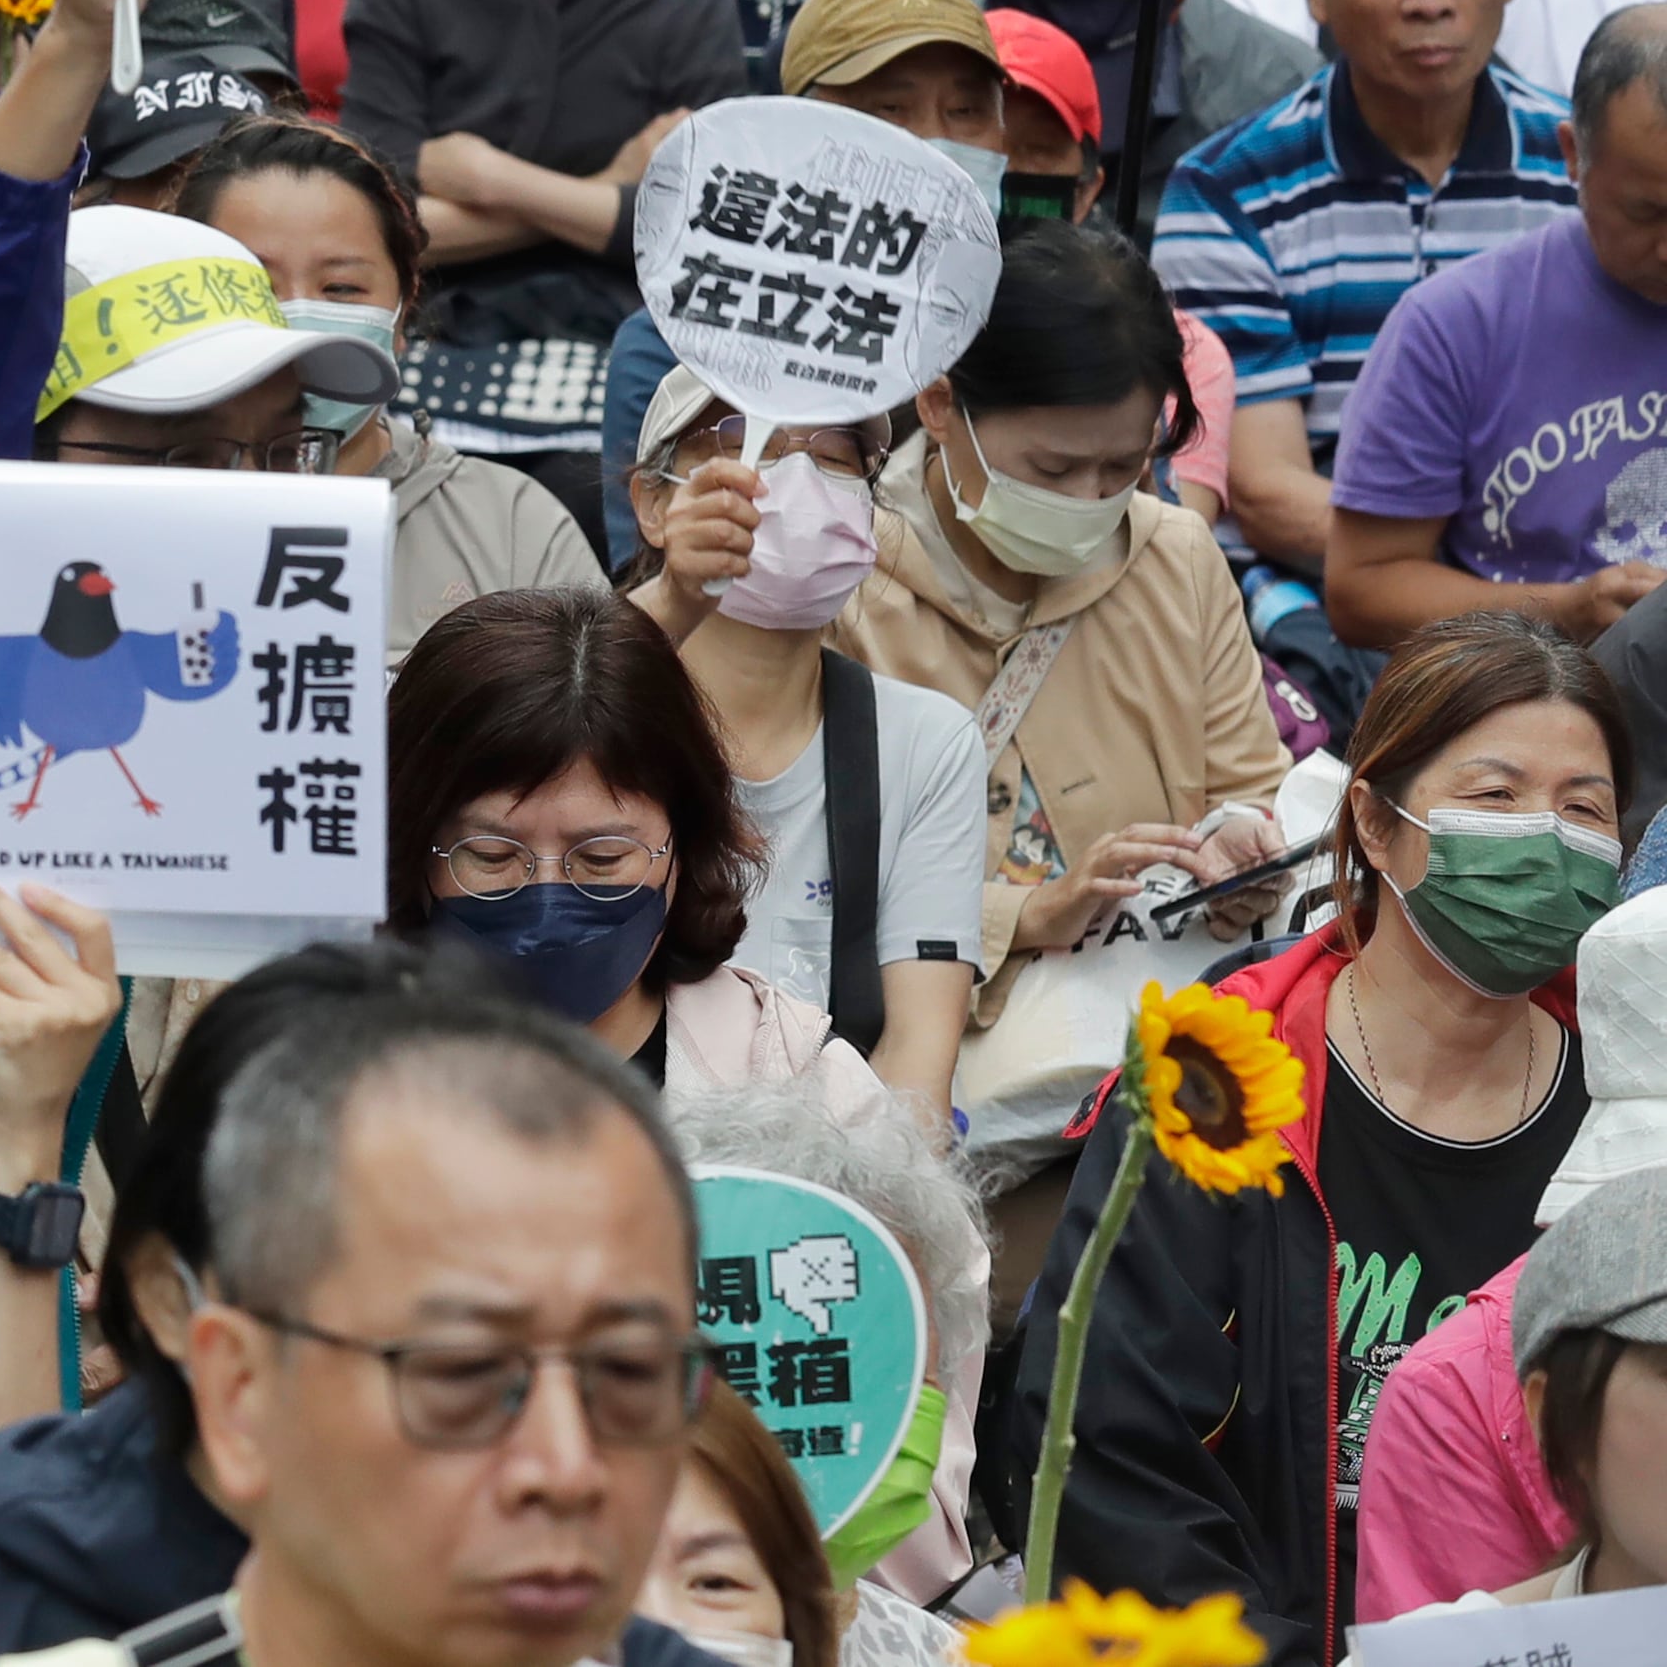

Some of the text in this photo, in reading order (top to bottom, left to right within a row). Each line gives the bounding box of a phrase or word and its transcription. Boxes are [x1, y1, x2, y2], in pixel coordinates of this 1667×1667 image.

[689, 163, 927, 276] 違法的
[669, 250, 901, 363] 在立法
[1483, 391, 1667, 549] TOO FAS
[252, 526, 362, 857] 反擴權
[19, 851, 45, 867] UP
[52, 851, 93, 868] LIKE
[100, 852, 112, 869] A
[121, 852, 230, 871] TAIWANESE
